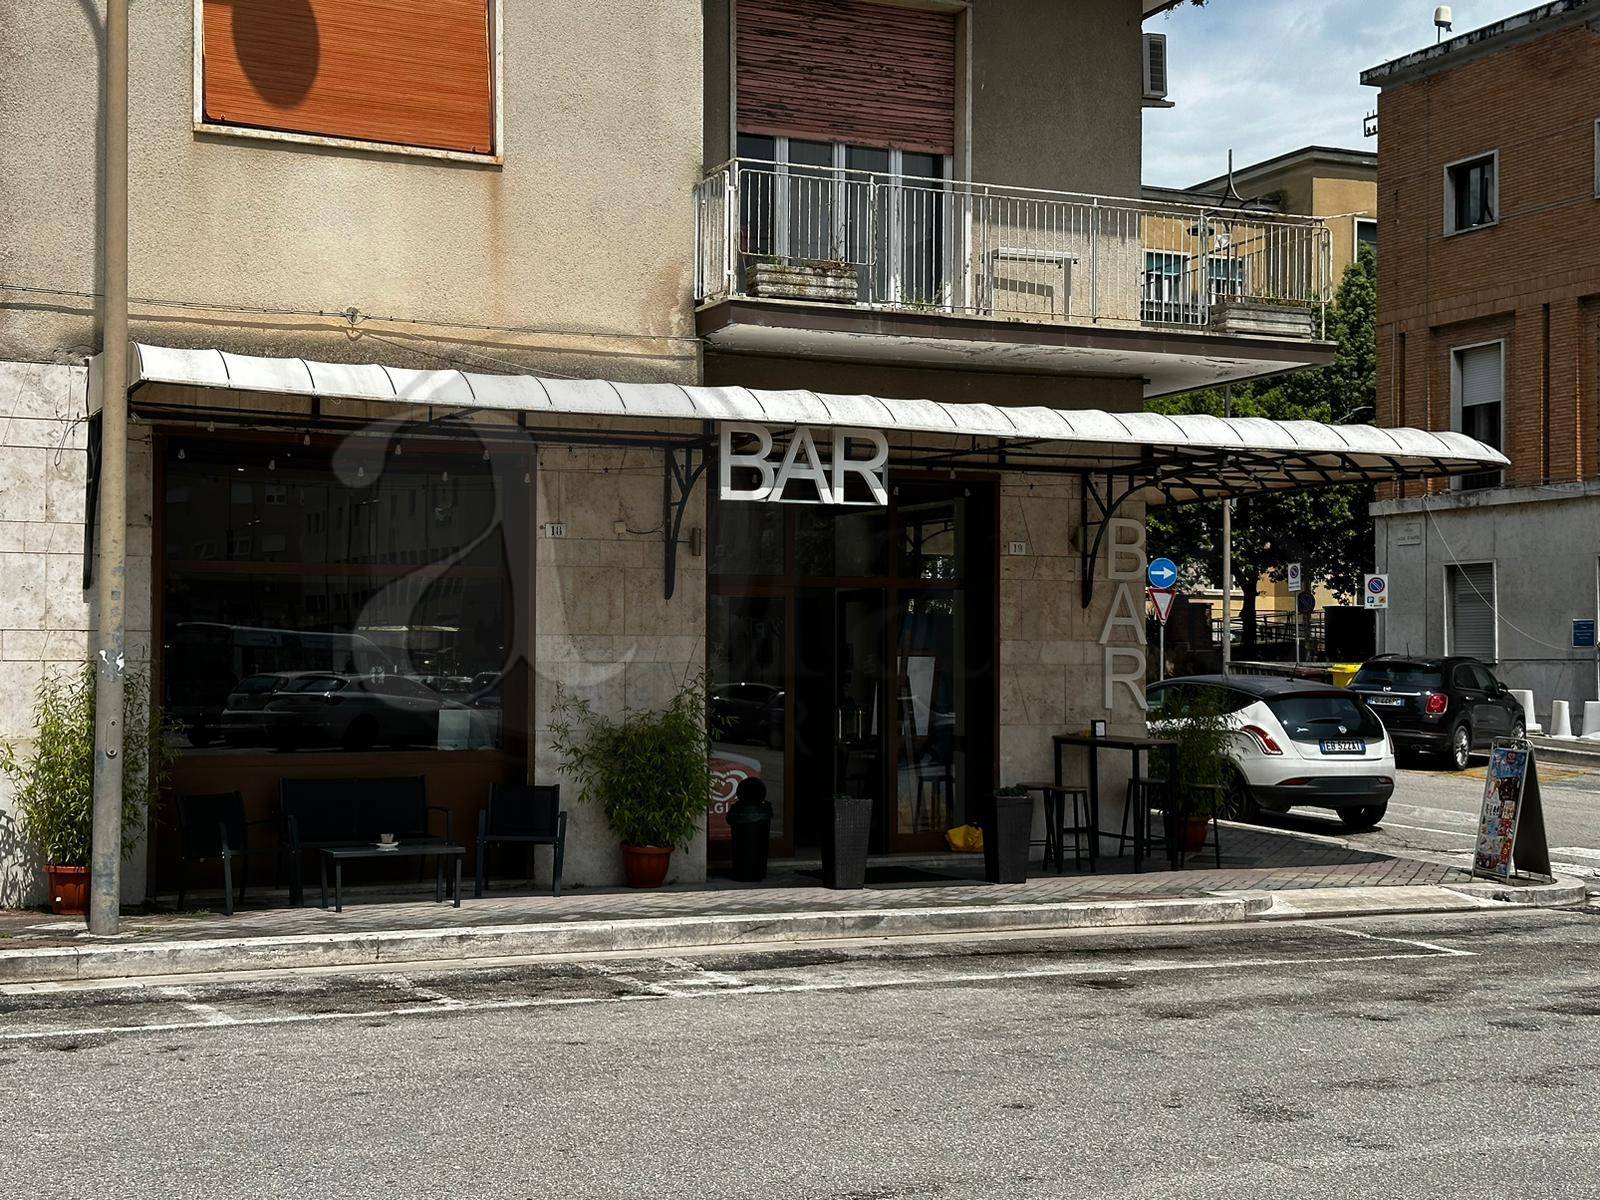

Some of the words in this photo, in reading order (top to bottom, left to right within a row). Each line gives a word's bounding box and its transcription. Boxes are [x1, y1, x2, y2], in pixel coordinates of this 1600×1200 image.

[720, 421, 889, 505] BAR
[551, 525, 562, 536] 18
[1013, 543, 1023, 553] 19
[1099, 517, 1149, 711] BAR
